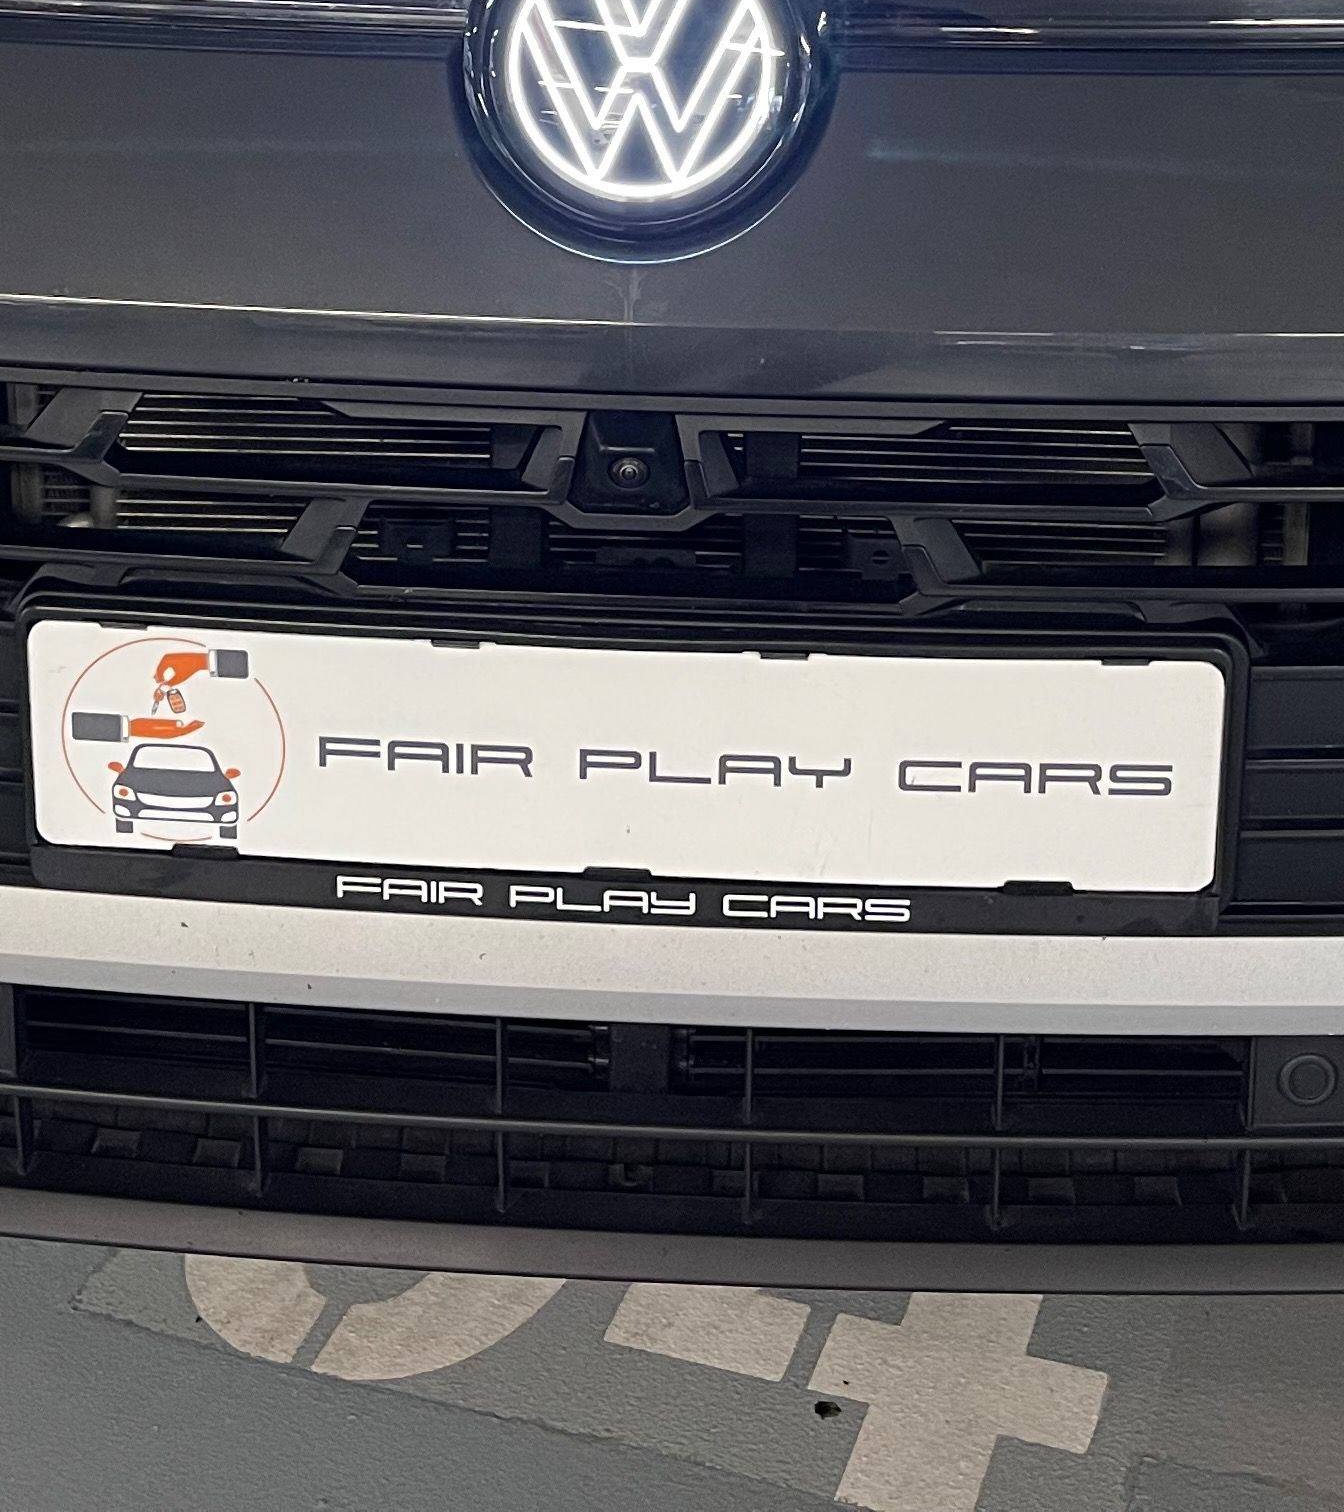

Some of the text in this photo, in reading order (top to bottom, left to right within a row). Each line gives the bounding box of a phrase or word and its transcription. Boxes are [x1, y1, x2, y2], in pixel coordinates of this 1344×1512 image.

[318, 736, 1173, 797] FAIR PLAY CARS
[336, 875, 911, 922] FAIR PLAY CARS
